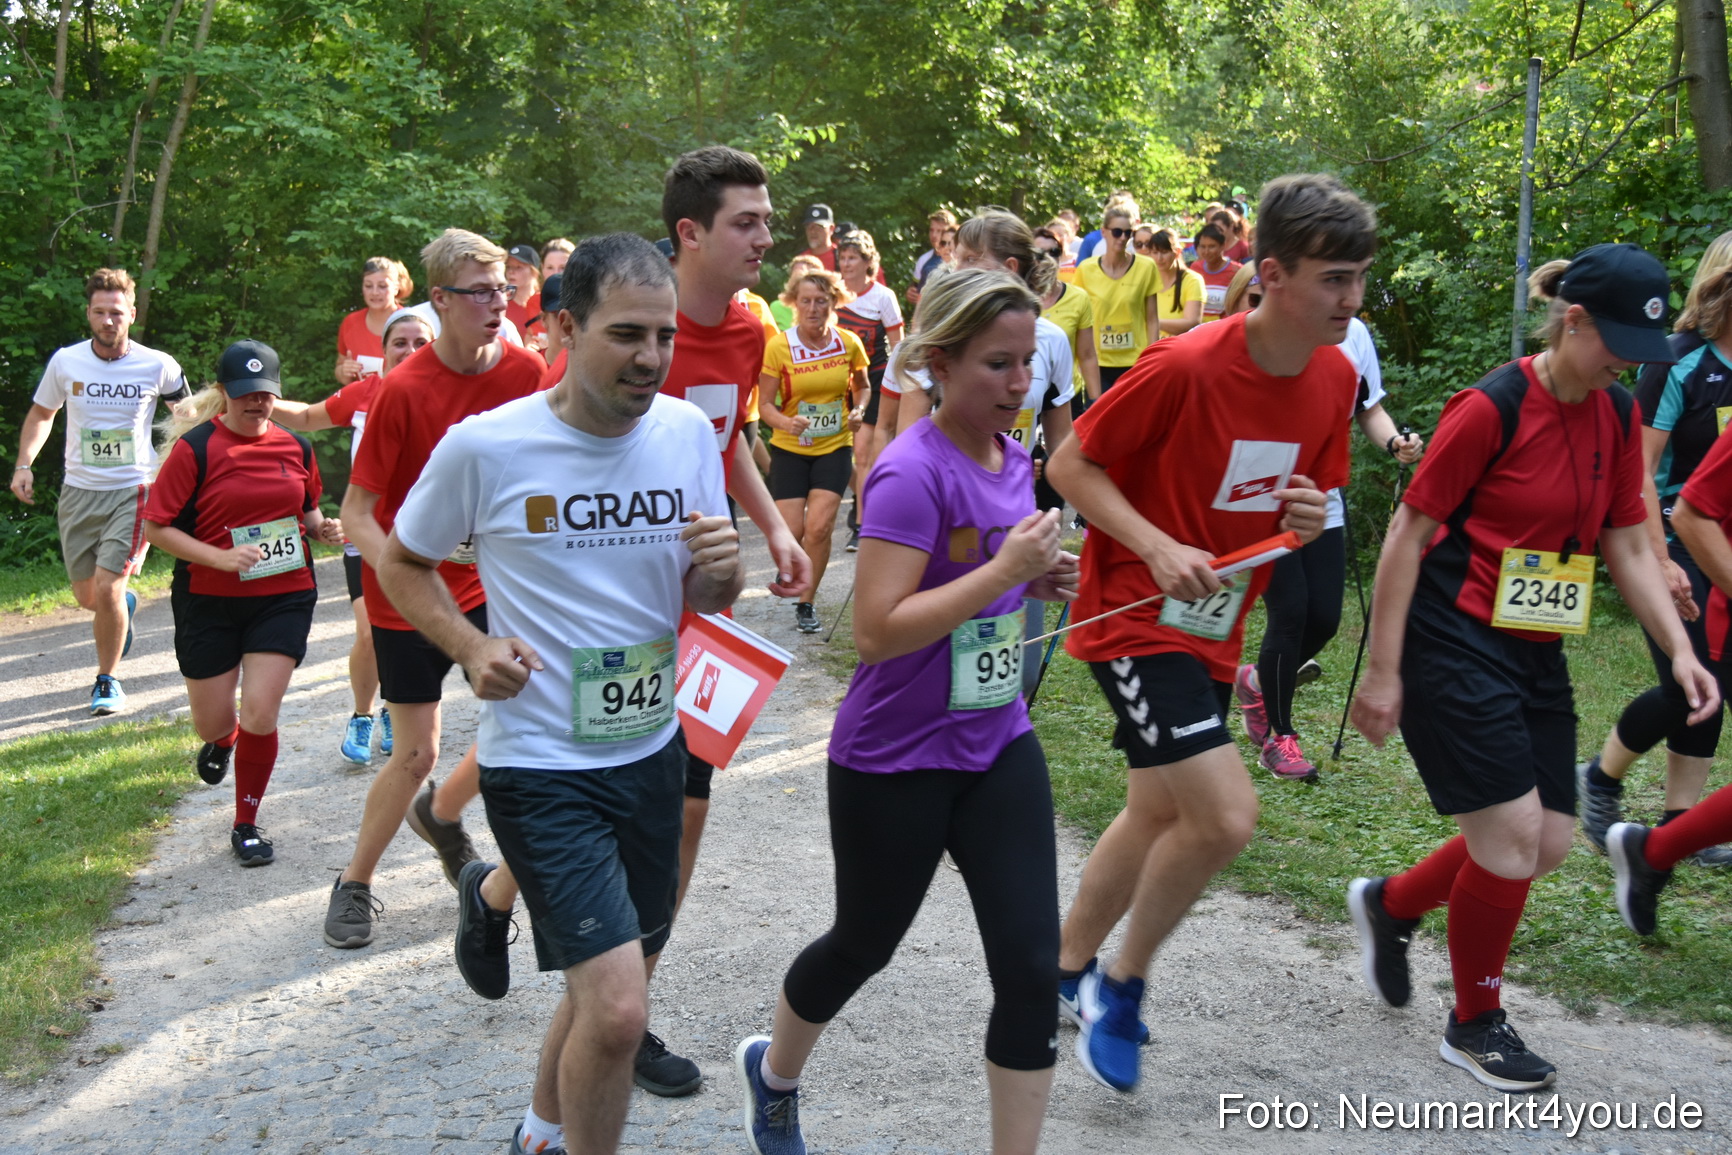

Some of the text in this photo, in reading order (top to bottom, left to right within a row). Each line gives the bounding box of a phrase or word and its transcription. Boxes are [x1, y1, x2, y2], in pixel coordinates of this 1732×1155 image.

[1102, 332, 1129, 345] 2191
[793, 358, 849, 375] MAX BÖGL
[87, 383, 146, 398] GRADL
[92, 442, 121, 456] 941
[563, 488, 690, 531] GRADL
[544, 517, 557, 531] R
[1508, 578, 1578, 611] 2348
[977, 643, 1020, 684] 939
[602, 673, 662, 715] 942
